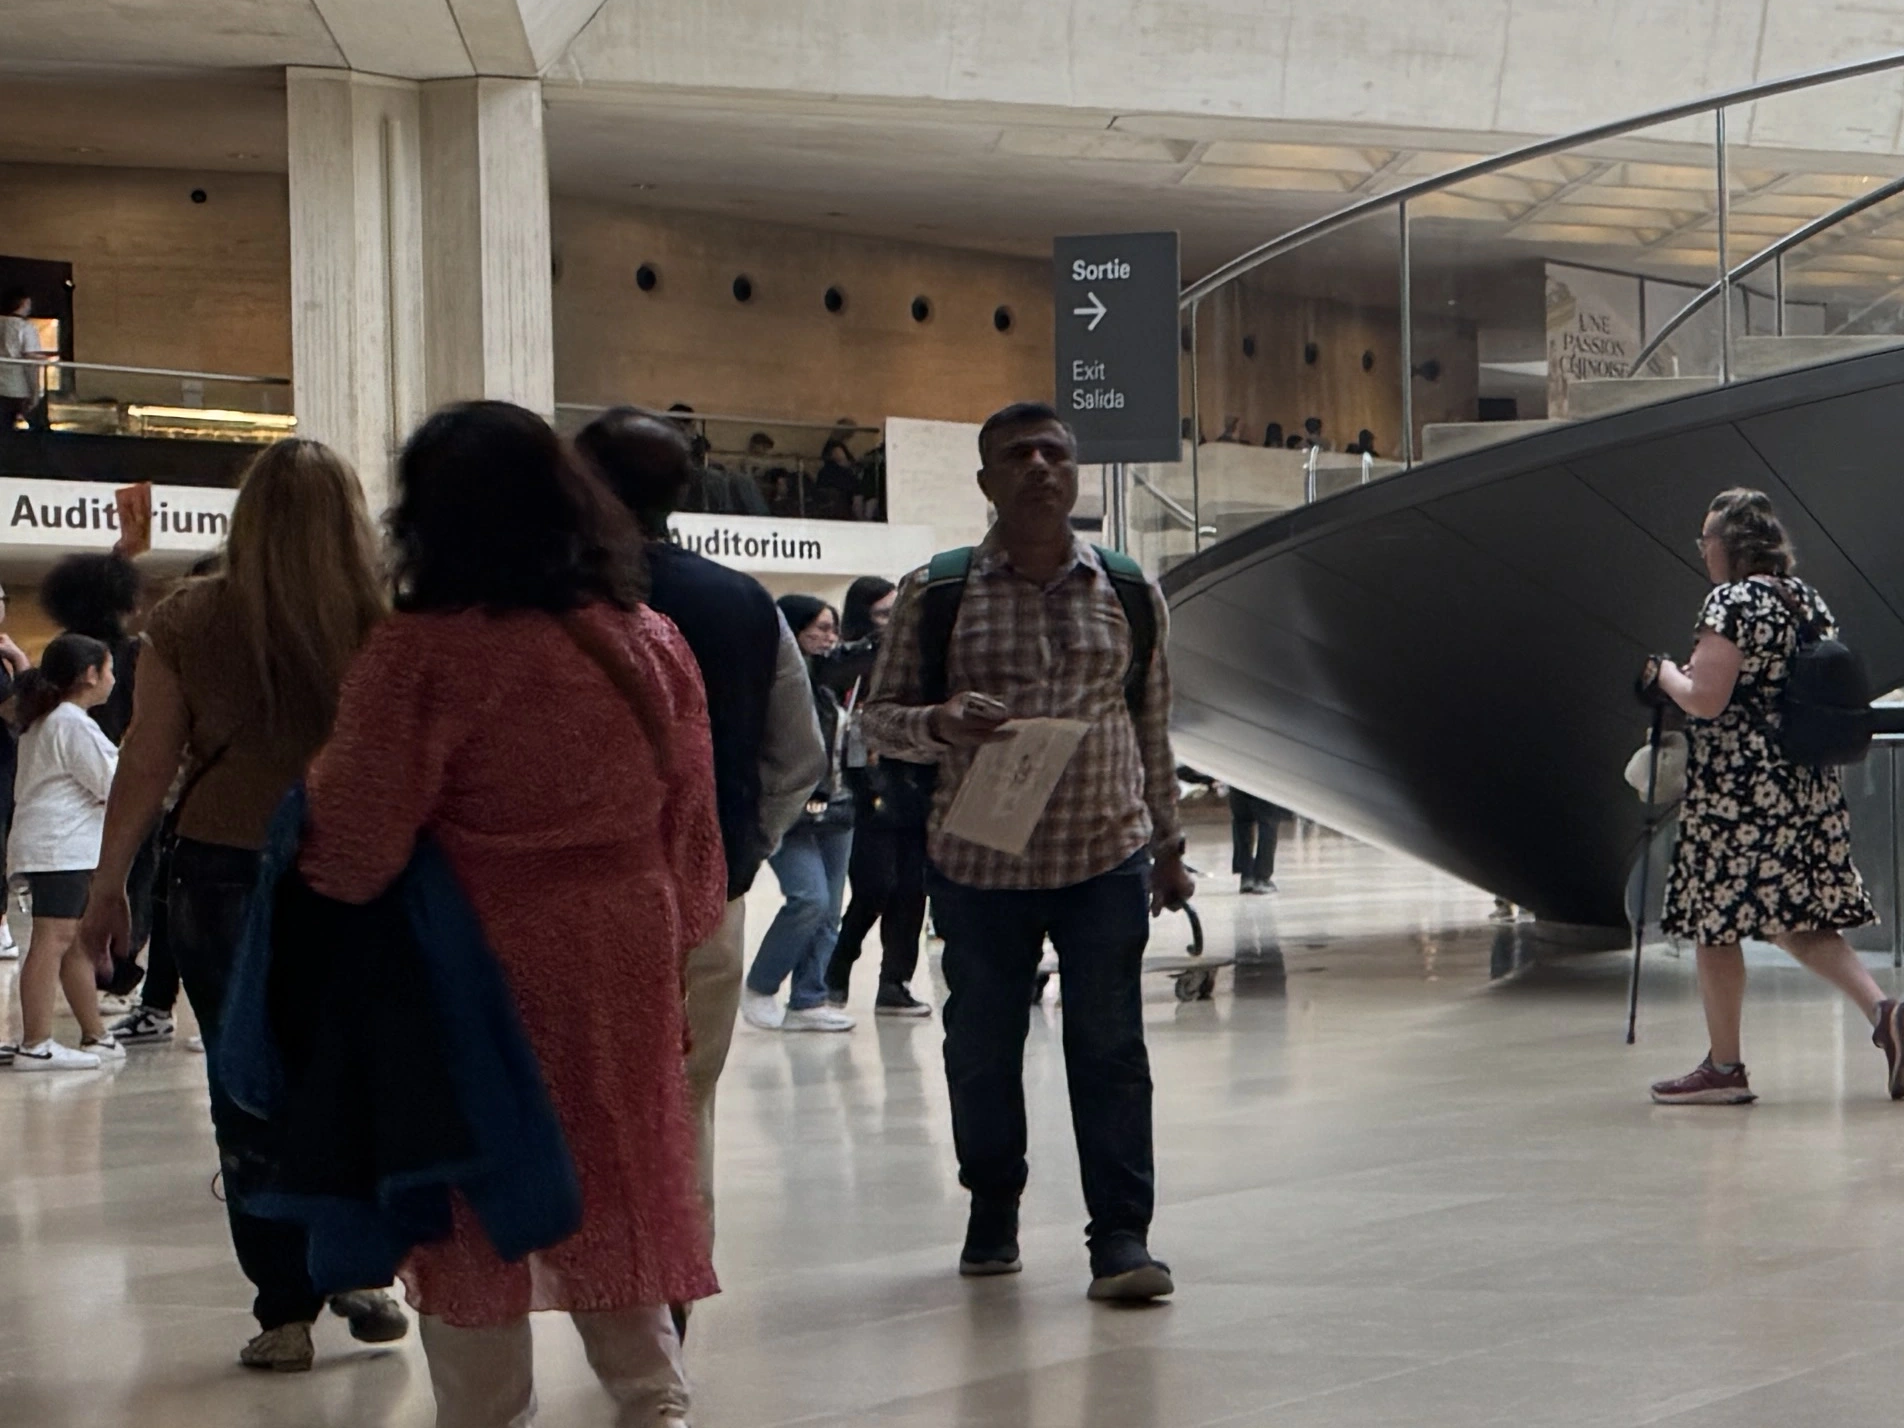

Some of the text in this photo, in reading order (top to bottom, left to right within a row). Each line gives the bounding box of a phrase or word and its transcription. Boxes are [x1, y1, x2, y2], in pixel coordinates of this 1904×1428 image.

[1072, 259, 1131, 281] Sortie
[1073, 360, 1105, 381] Exit
[1072, 389, 1125, 410] Salida
[10, 495, 229, 535] Auditium
